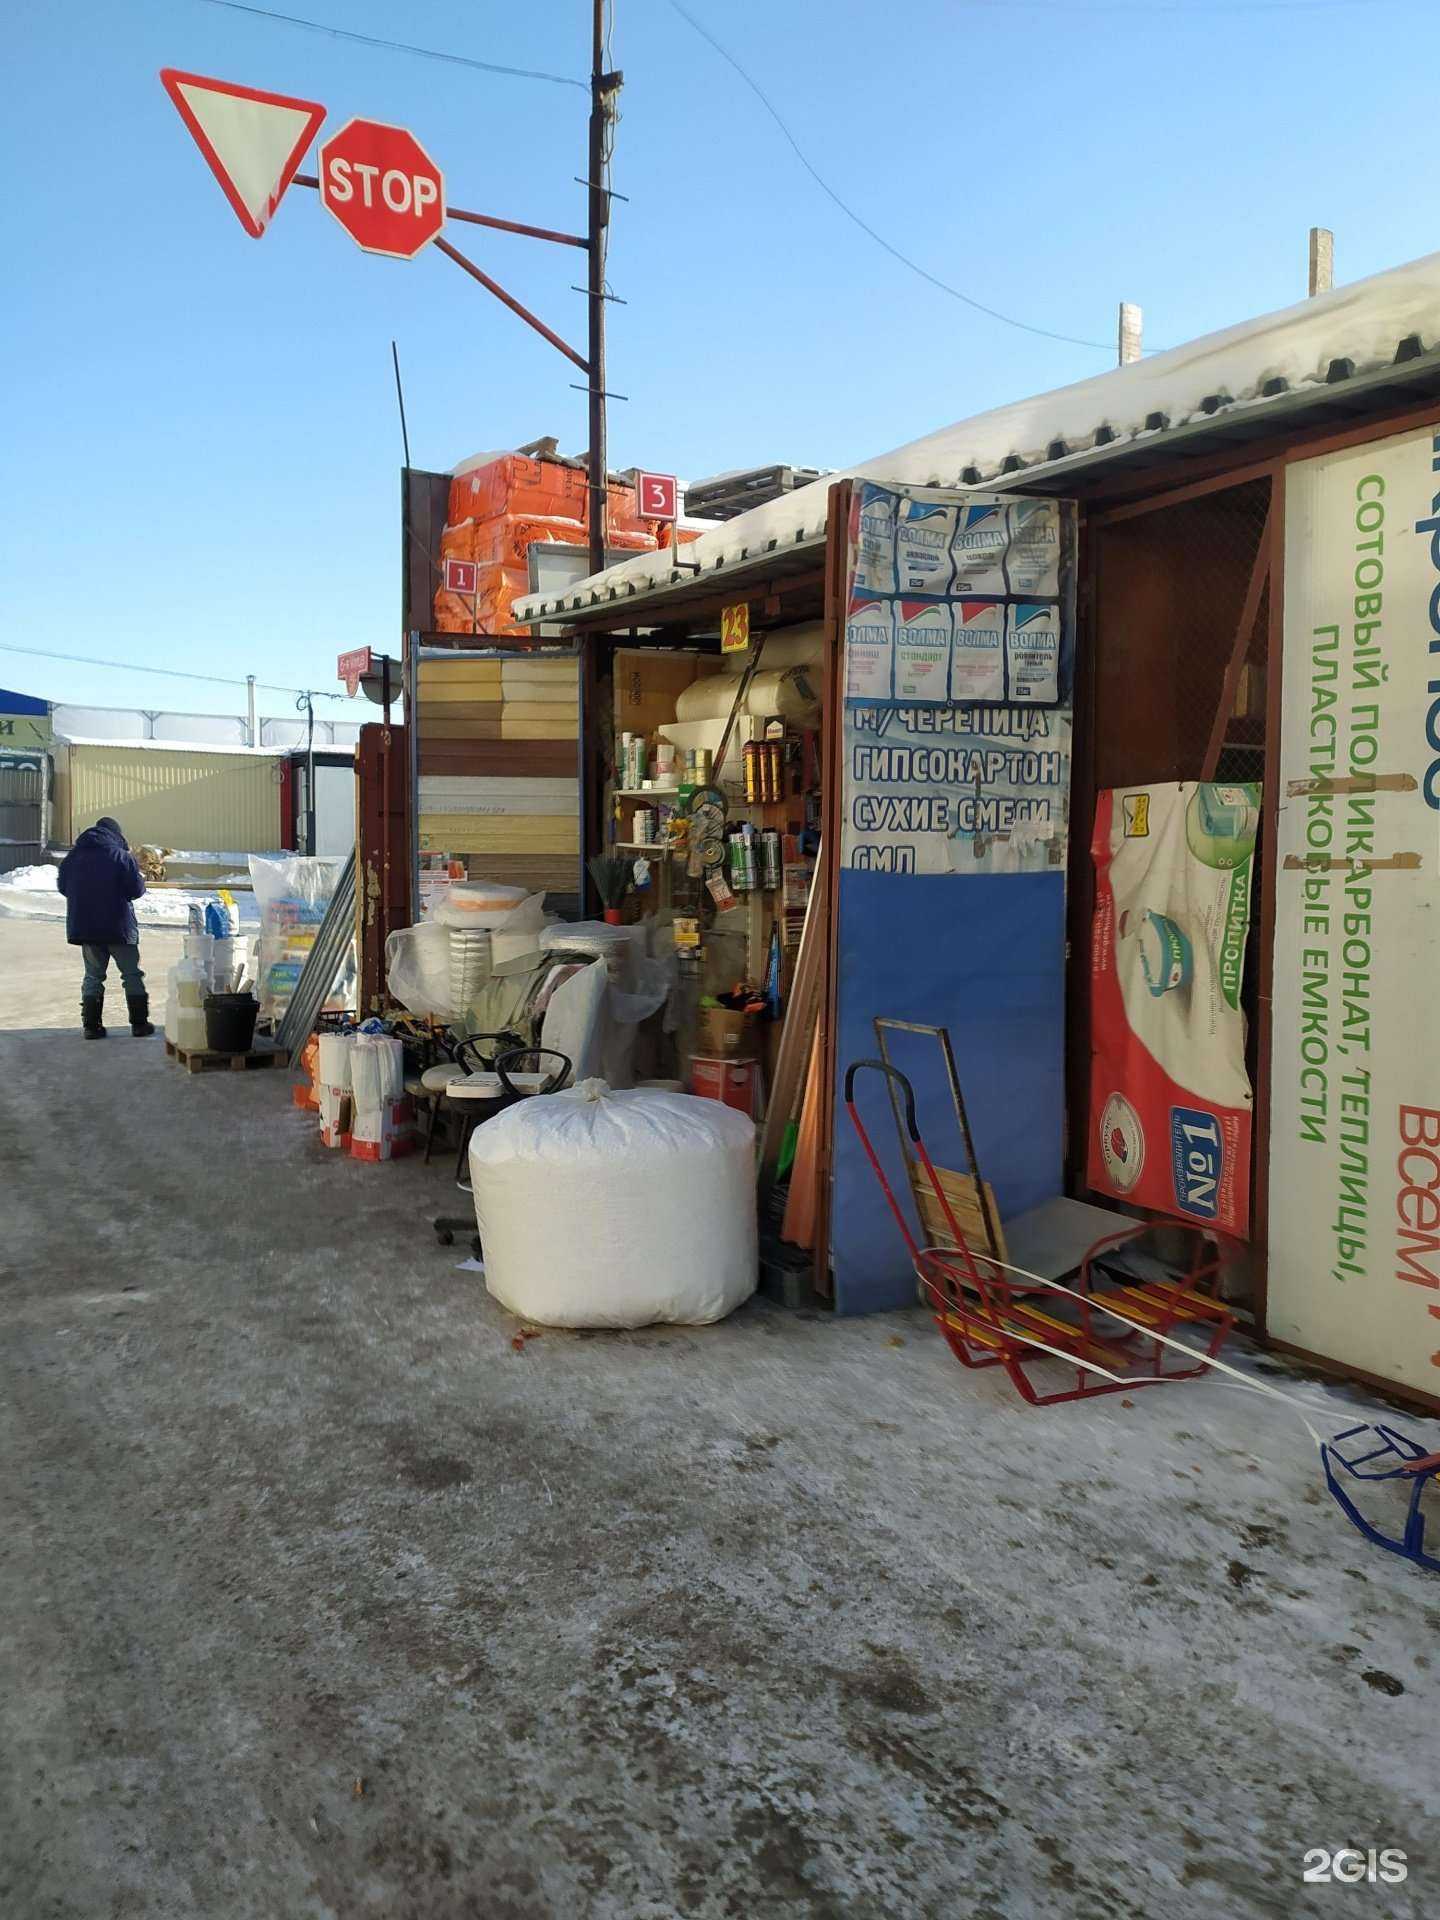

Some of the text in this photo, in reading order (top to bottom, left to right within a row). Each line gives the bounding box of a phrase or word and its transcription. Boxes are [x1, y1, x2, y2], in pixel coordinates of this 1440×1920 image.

[328, 157, 437, 218] STOP
[650, 484, 667, 508] 3
[953, 530, 1006, 551] ВОЛМА
[456, 568, 467, 586] 1
[723, 606, 748, 647] 23
[897, 627, 946, 648] ВОЛМА
[955, 629, 1000, 648] ВОЛМА
[1009, 631, 1057, 651] ВОЛМА
[853, 745, 1061, 785] ГИПСОКАРТОН
[853, 796, 949, 832] СУХИЕ
[1298, 624, 1340, 1144] ПЛАСТИКОВЫЕ ЕМКОСТИ
[1330, 474, 1389, 1283] СОТОВЫЙ ПОЛИКАРБОНАТ, ТЕПЛИЦЫ,
[1222, 874, 1247, 990] ПРОПИТКА
